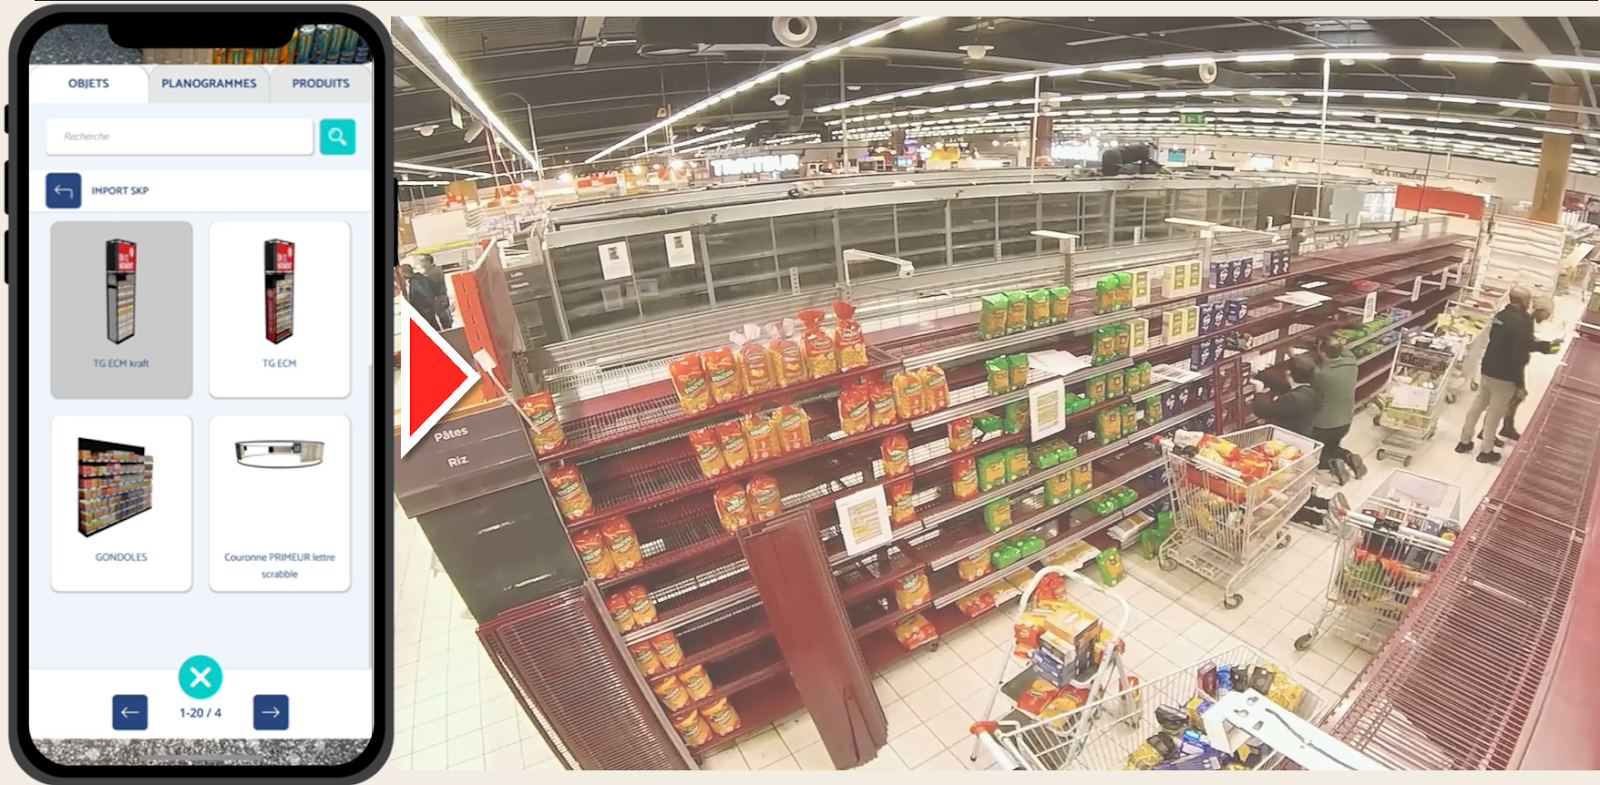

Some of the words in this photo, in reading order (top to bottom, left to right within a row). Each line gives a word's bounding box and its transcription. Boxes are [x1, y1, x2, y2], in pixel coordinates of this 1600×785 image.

[68, 78, 110, 90] OBJETS
[161, 78, 257, 89] PLANOGRAMMES
[292, 78, 350, 89] PRODUITS
[63, 131, 110, 141] Recherche
[91, 186, 129, 196] IMPORT
[131, 186, 149, 196] SKP
[93, 358, 106, 368] TG
[108, 358, 128, 368] ECM
[129, 358, 149, 368] kraft
[263, 358, 275, 368] TG
[277, 358, 297, 368] ECM
[434, 427, 469, 443] Pâtes
[447, 456, 469, 468] Riz
[95, 552, 147, 562] GONDOLES
[224, 552, 267, 562] Couronne
[269, 552, 310, 562] PRIMEUR
[312, 552, 335, 562] lettre
[261, 569, 298, 579] scrabble
[180, 707, 204, 719] 1-20
[206, 707, 212, 719] /
[214, 707, 222, 719] 4
